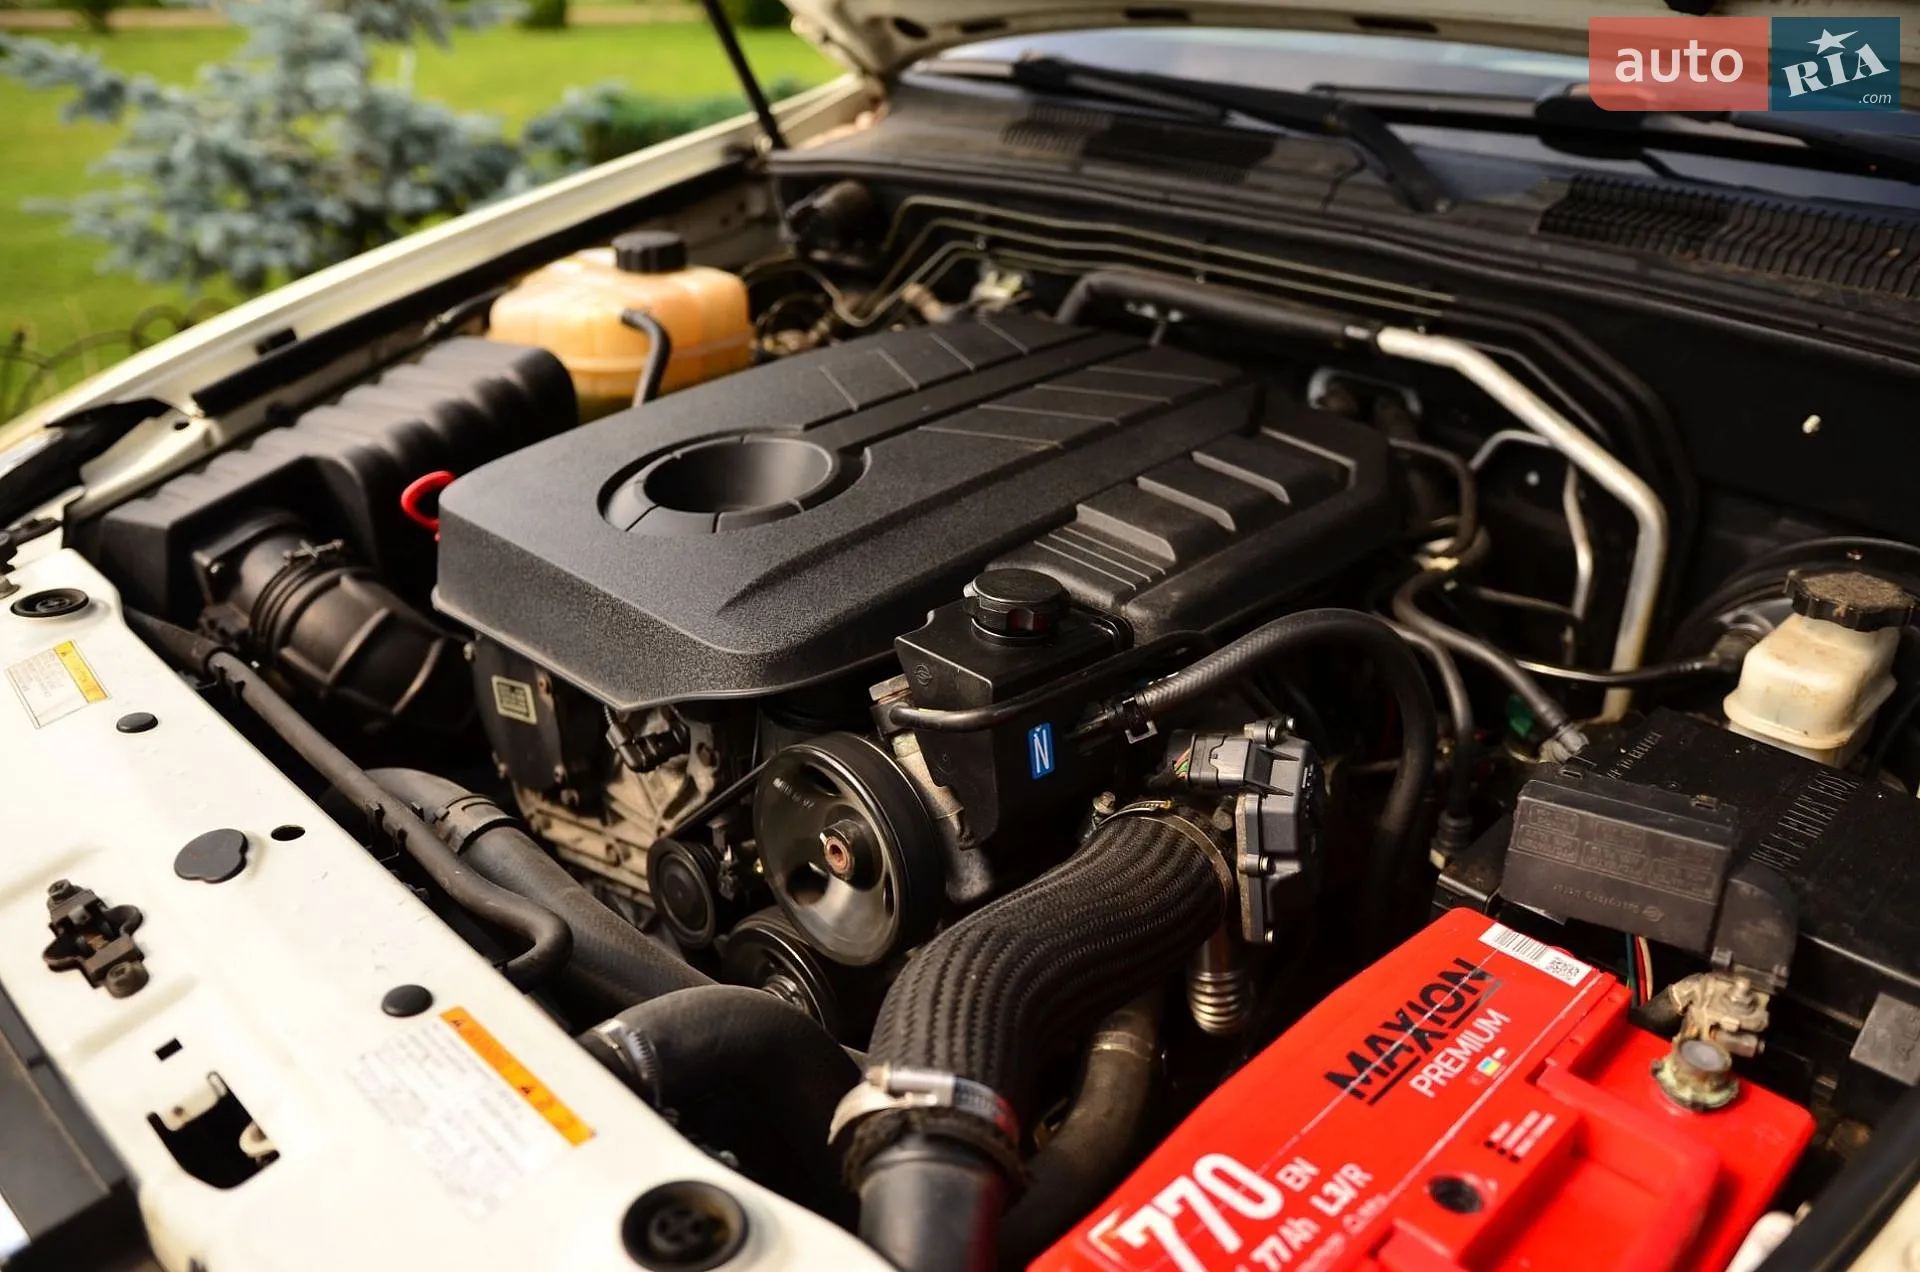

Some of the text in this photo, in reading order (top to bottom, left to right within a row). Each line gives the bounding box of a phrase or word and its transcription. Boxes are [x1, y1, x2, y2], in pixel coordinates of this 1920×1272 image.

[1324, 957, 1495, 1101] MAXION
[1408, 1007, 1512, 1099] PREMIUM
[1117, 1152, 1285, 1272] 770
[1274, 1155, 1321, 1193] EN
